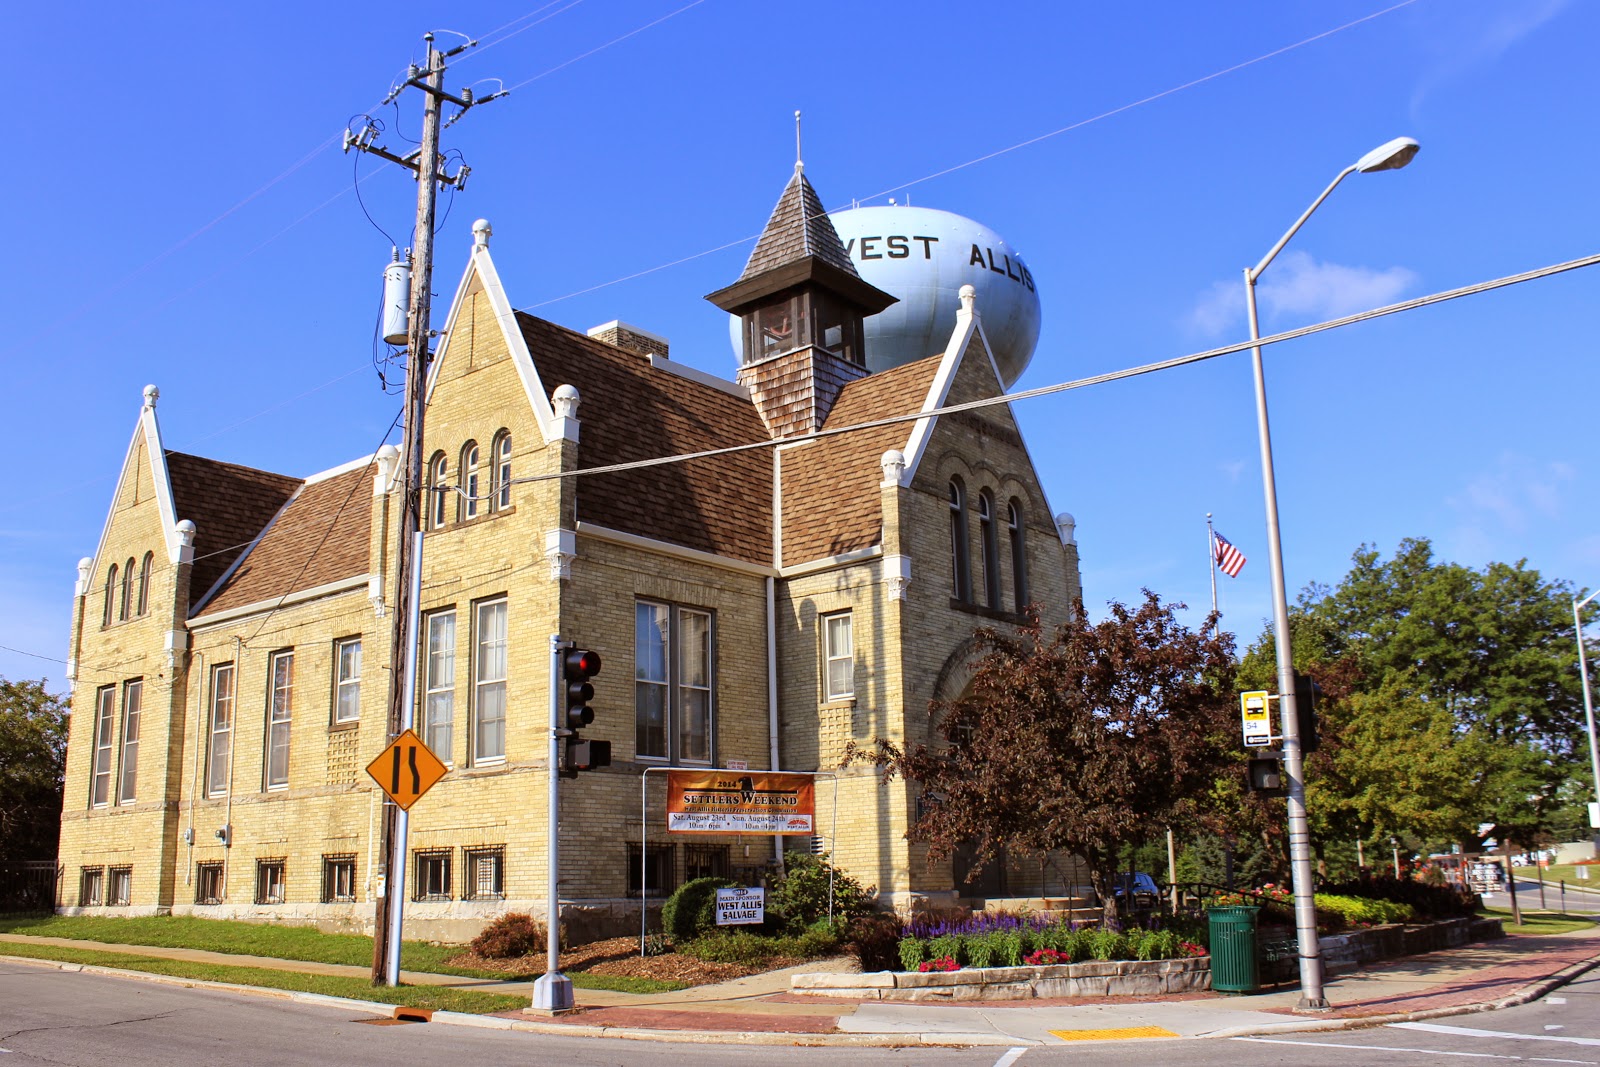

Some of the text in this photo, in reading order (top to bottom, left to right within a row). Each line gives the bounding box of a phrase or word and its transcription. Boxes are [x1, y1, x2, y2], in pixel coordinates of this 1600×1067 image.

[969, 243, 1035, 293] ALLIS
[684, 791, 798, 805] SETTLERS WEEKEND
[686, 814, 710, 823] August
[711, 814, 727, 822] 23rd
[747, 815, 771, 823] August
[770, 815, 786, 823] 24th
[718, 901, 762, 911] WEST ALLIS
[722, 910, 757, 920] SALVAGE
